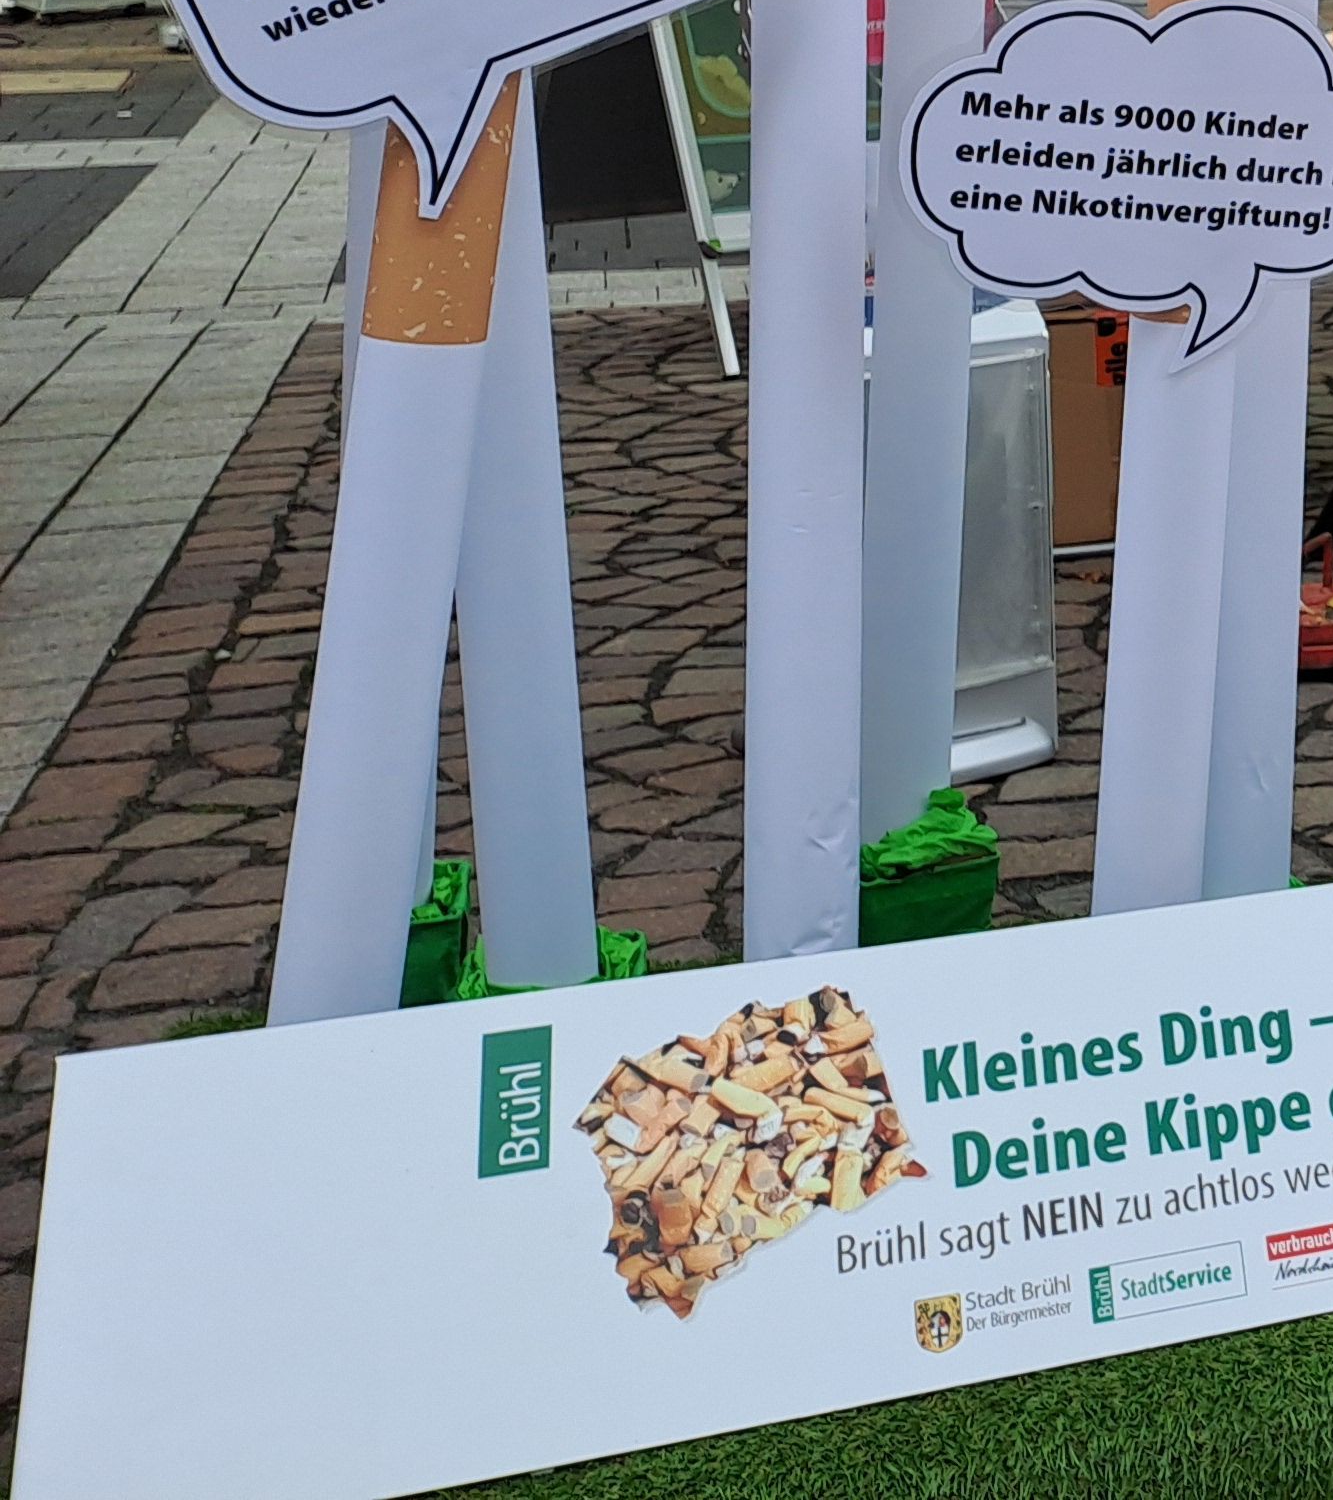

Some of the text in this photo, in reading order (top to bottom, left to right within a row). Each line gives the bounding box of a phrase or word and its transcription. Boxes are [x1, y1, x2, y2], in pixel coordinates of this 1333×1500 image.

[922, 1031, 1142, 1102] Kleines
[1159, 1005, 1292, 1065] Ding
[499, 1061, 542, 1166] Brühl
[951, 1116, 1126, 1188] Deine
[1144, 1091, 1311, 1161] Kippe
[965, 1274, 1072, 1311] Stadt Brühl
[1095, 1270, 1113, 1318] Brühl
[1120, 1263, 1232, 1301] StadtService
[966, 1301, 1072, 1332] Der Bürgermeister
